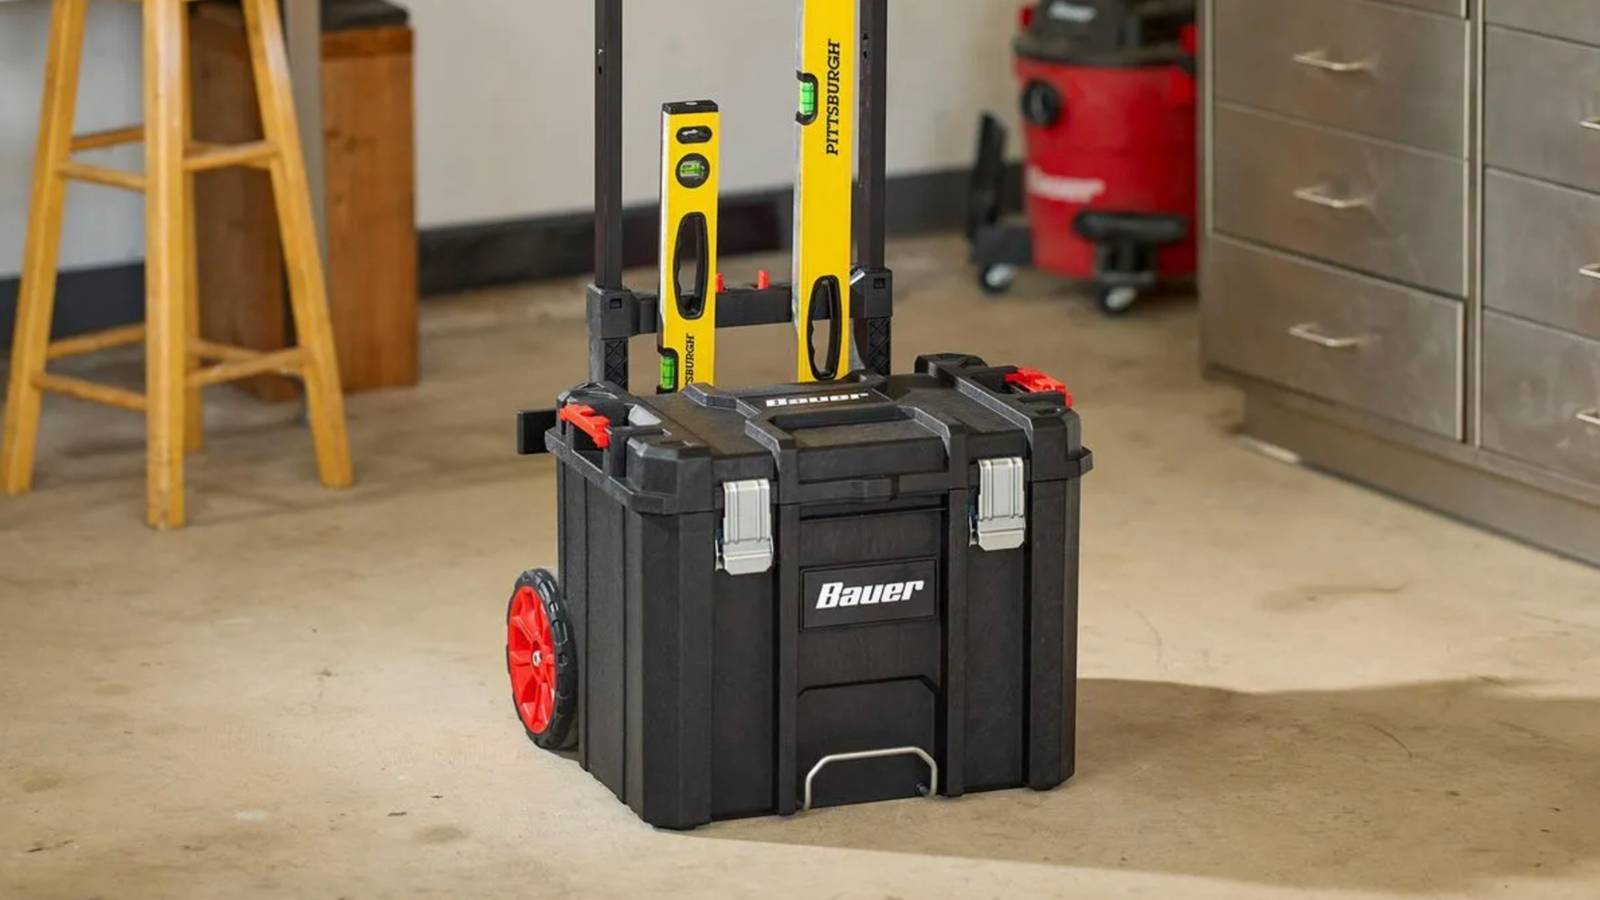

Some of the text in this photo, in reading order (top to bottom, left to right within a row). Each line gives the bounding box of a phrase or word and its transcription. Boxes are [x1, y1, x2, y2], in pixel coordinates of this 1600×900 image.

[826, 38, 840, 156] PITTSBURGH
[685, 333, 695, 385] SBURGH
[815, 580, 925, 609] Bauer
